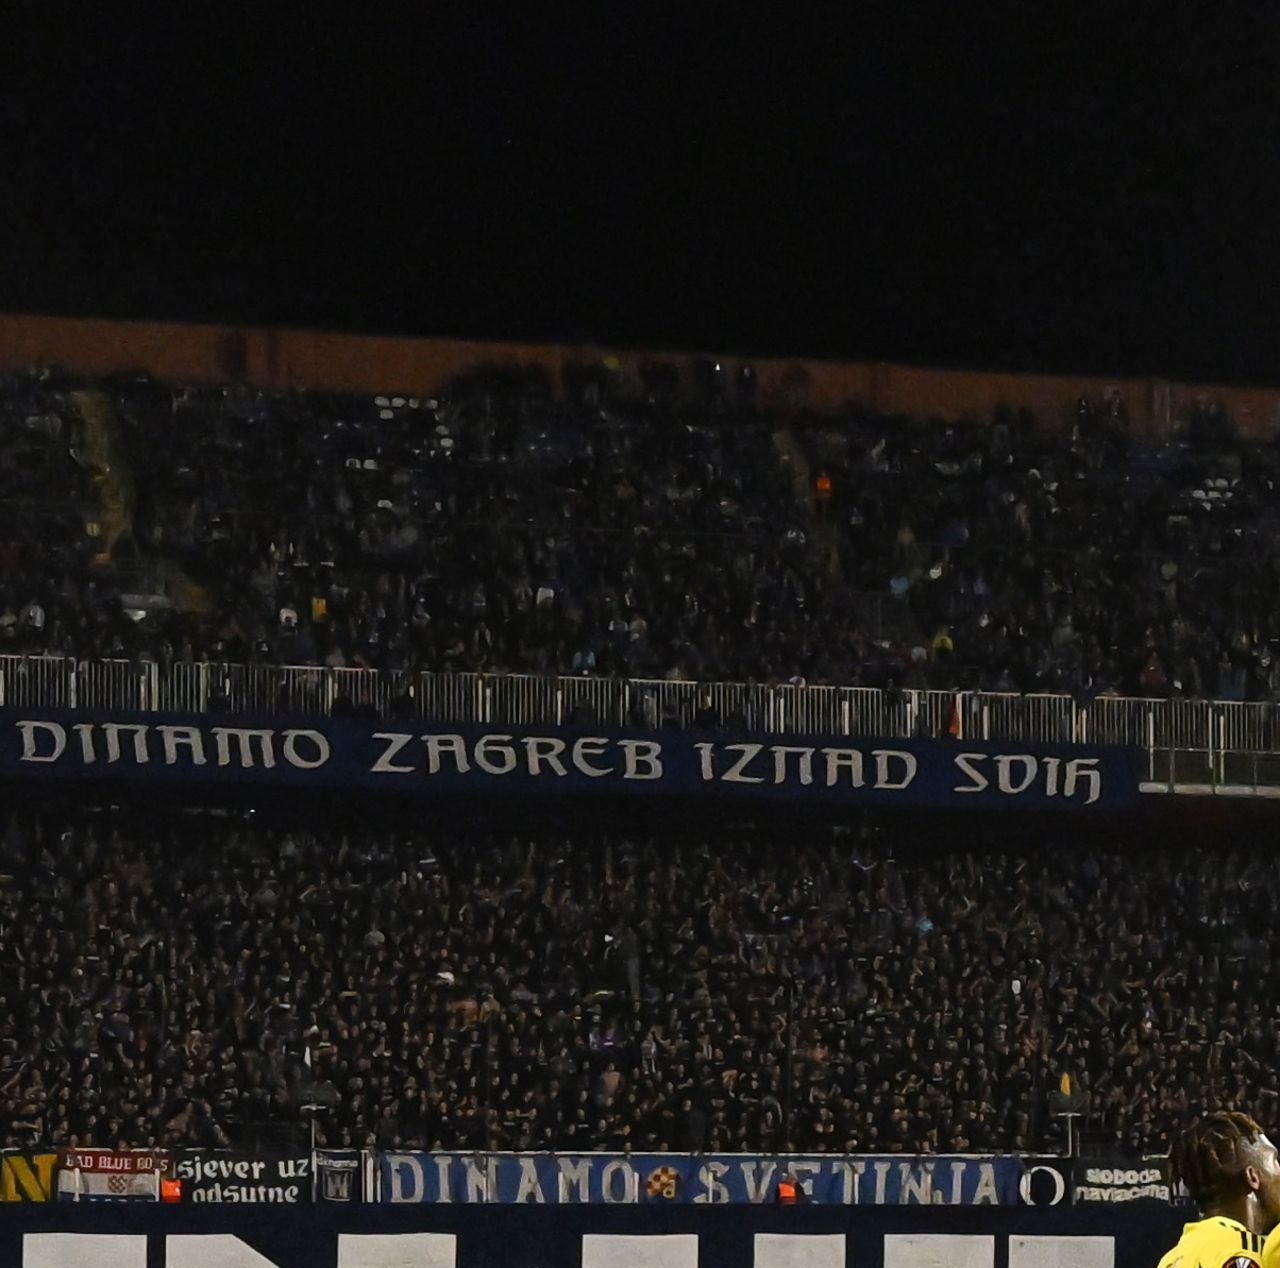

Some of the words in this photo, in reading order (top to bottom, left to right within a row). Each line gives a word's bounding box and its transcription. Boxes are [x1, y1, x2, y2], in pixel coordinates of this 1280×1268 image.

[15, 720, 331, 769] DINAMO
[370, 732, 663, 780] ZAGREB
[693, 742, 918, 790] IZNAD
[98, 1157, 131, 1170] BLUE
[136, 1157, 169, 1172] BOS
[177, 1156, 266, 1183] sjever
[278, 1158, 309, 1179] uz
[390, 1154, 636, 1203] DINAMO
